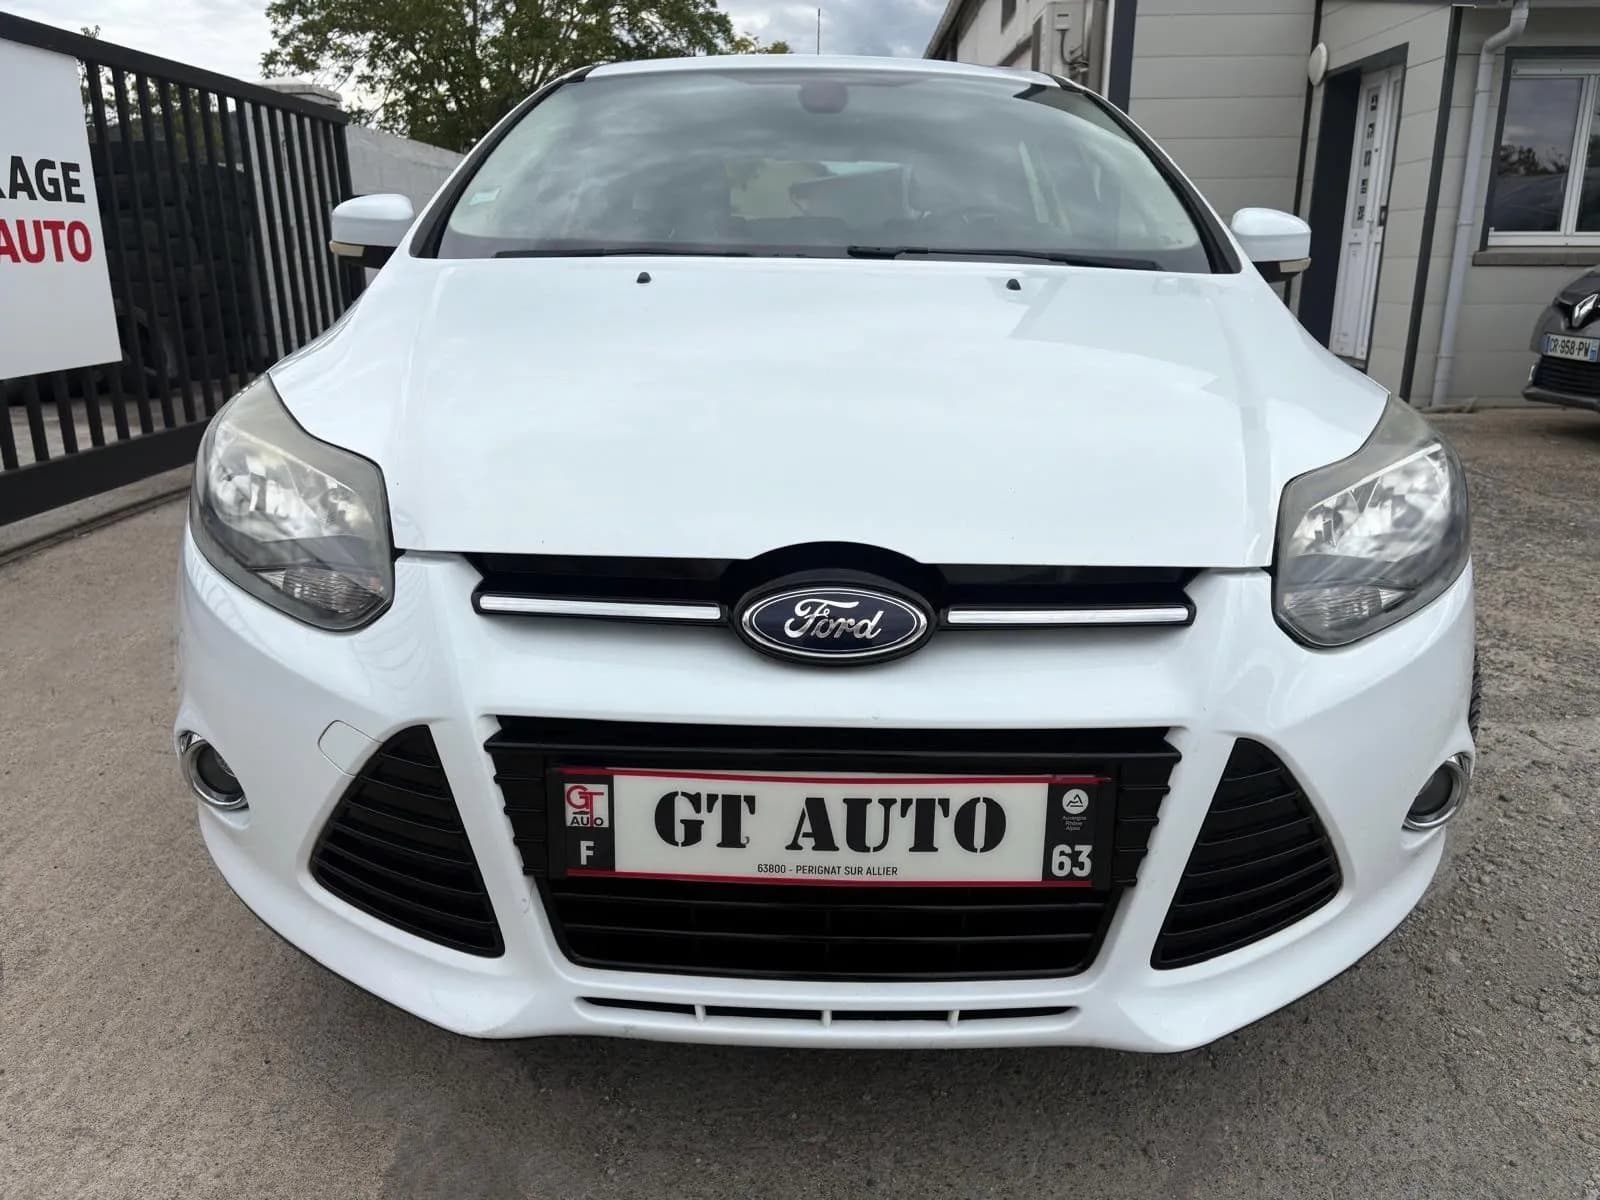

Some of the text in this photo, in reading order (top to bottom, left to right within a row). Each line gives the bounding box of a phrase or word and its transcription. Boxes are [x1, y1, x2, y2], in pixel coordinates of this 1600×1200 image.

[0, 155, 86, 204] AGE
[0, 218, 92, 263] AUTO
[784, 599, 884, 639] Ford
[566, 785, 605, 820] GT
[654, 791, 1007, 853] GT AUTO
[580, 840, 594, 865] F
[757, 863, 786, 874] 63800
[795, 864, 841, 875] PERIGNAT
[843, 865, 864, 876] SUR
[865, 866, 898, 876] ALLIER
[1051, 843, 1093, 877] 63
